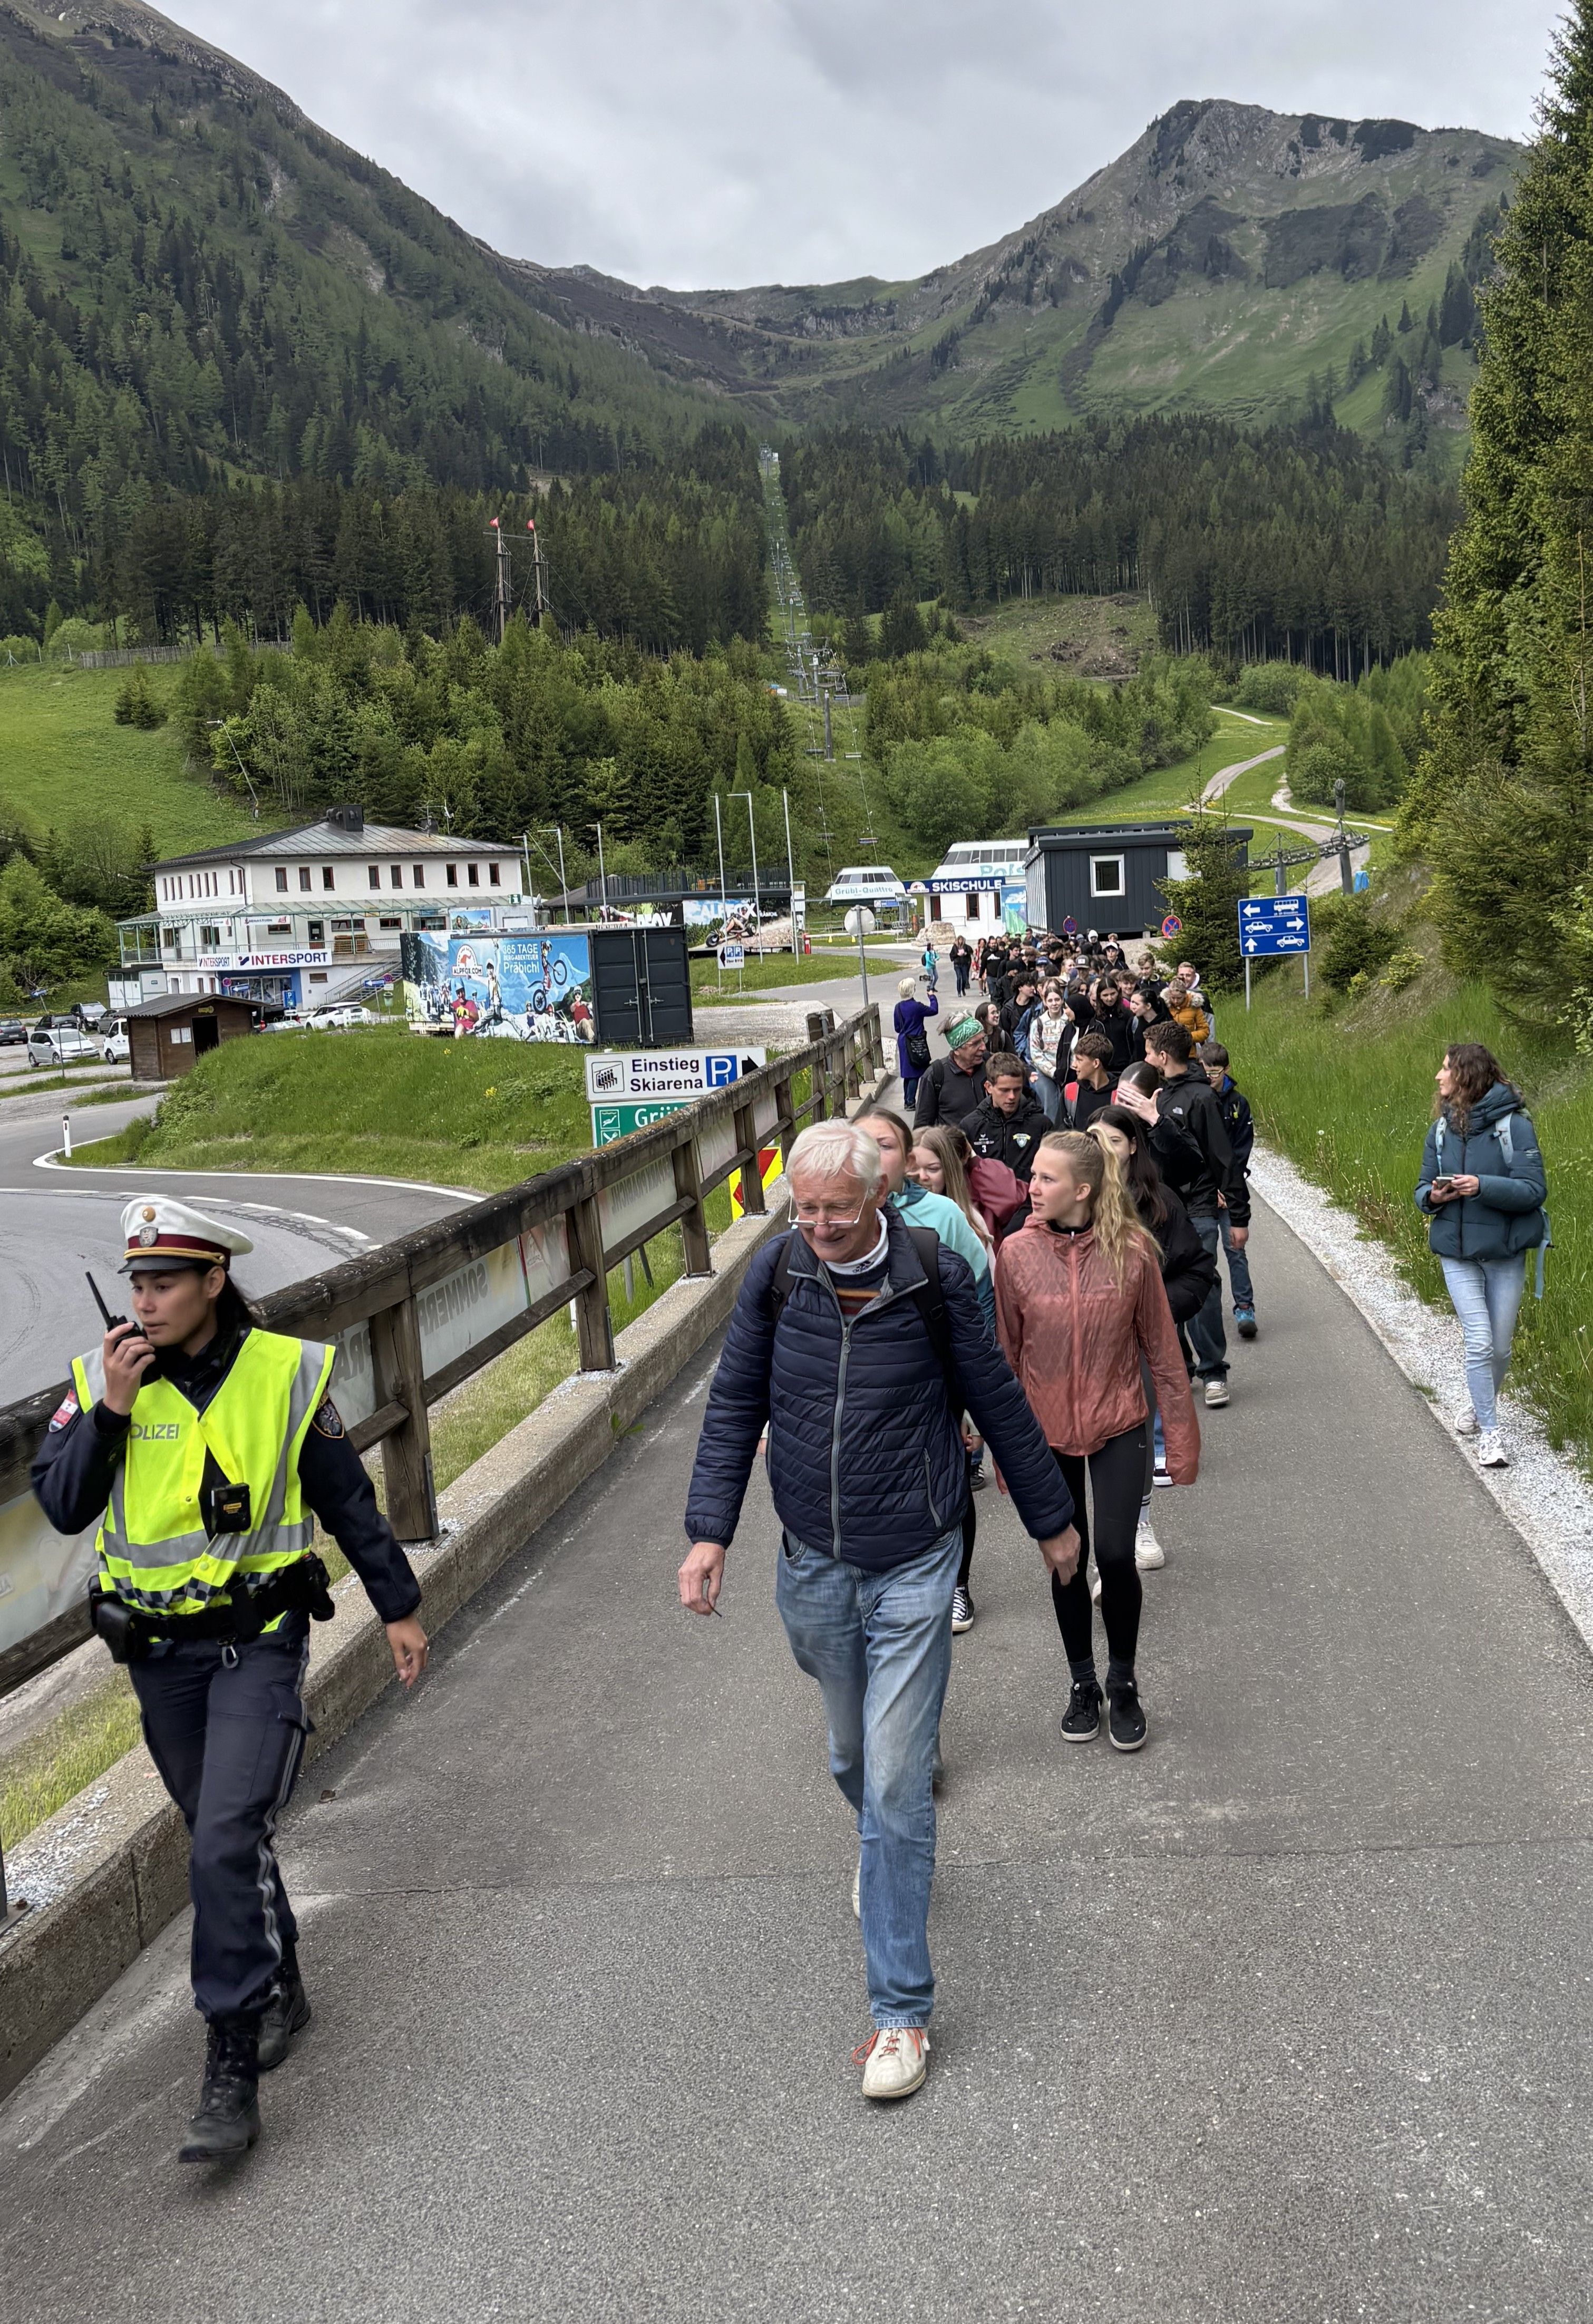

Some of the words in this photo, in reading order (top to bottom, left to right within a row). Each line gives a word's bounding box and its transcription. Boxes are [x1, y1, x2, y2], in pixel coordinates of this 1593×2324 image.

[932, 880, 1002, 892] SKISCHULE
[503, 944, 516, 954] 365
[518, 944, 538, 954] TAGE
[203, 956, 230, 967] INTERSPORT
[251, 952, 327, 965] INTERSPORT
[504, 962, 540, 973] Präbichl
[633, 1058, 699, 1073] Einstieg
[630, 1077, 703, 1092] Skiarena
[982, 1145, 987, 1153] 3
[130, 1424, 179, 1440] OLIZEI
